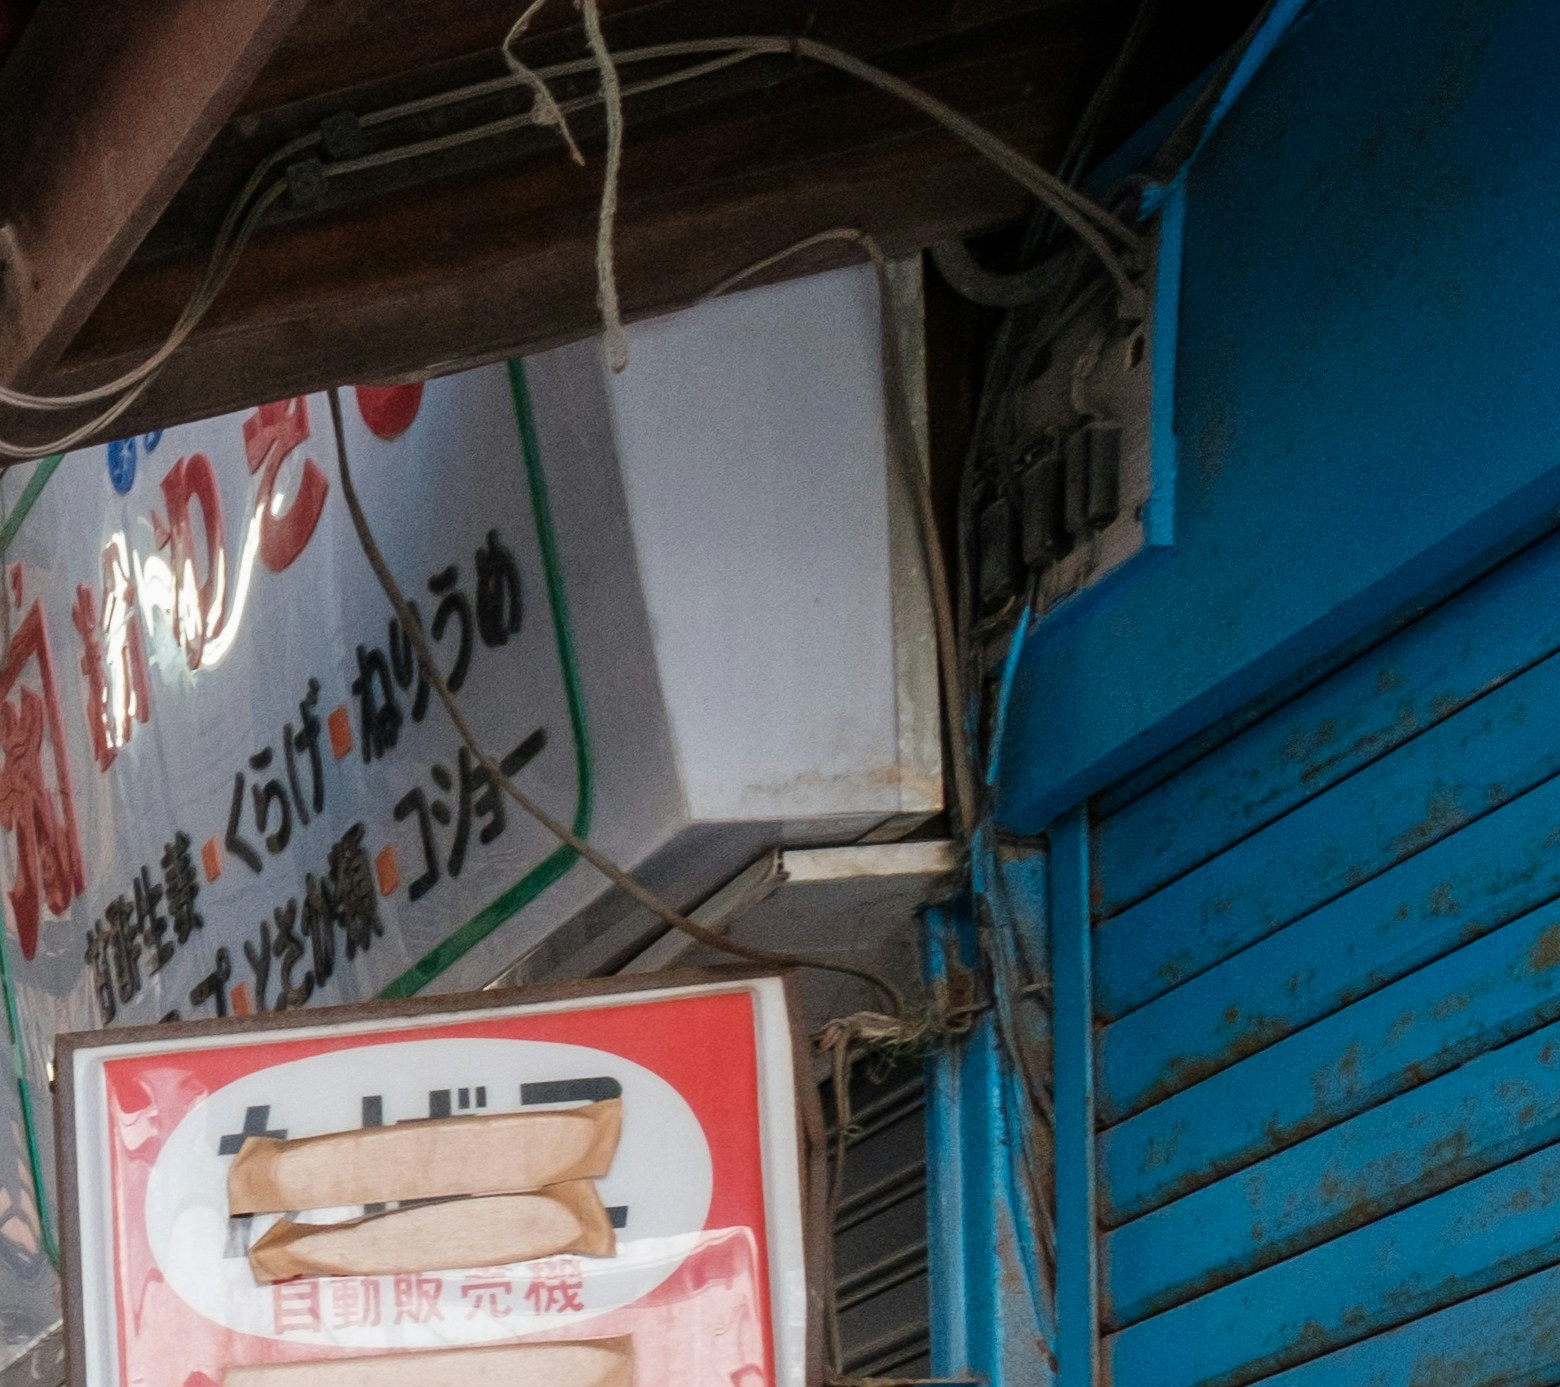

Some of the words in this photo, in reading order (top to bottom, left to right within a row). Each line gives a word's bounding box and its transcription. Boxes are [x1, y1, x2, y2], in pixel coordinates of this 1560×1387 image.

[273, 1259, 586, 1335] 自動販売機
